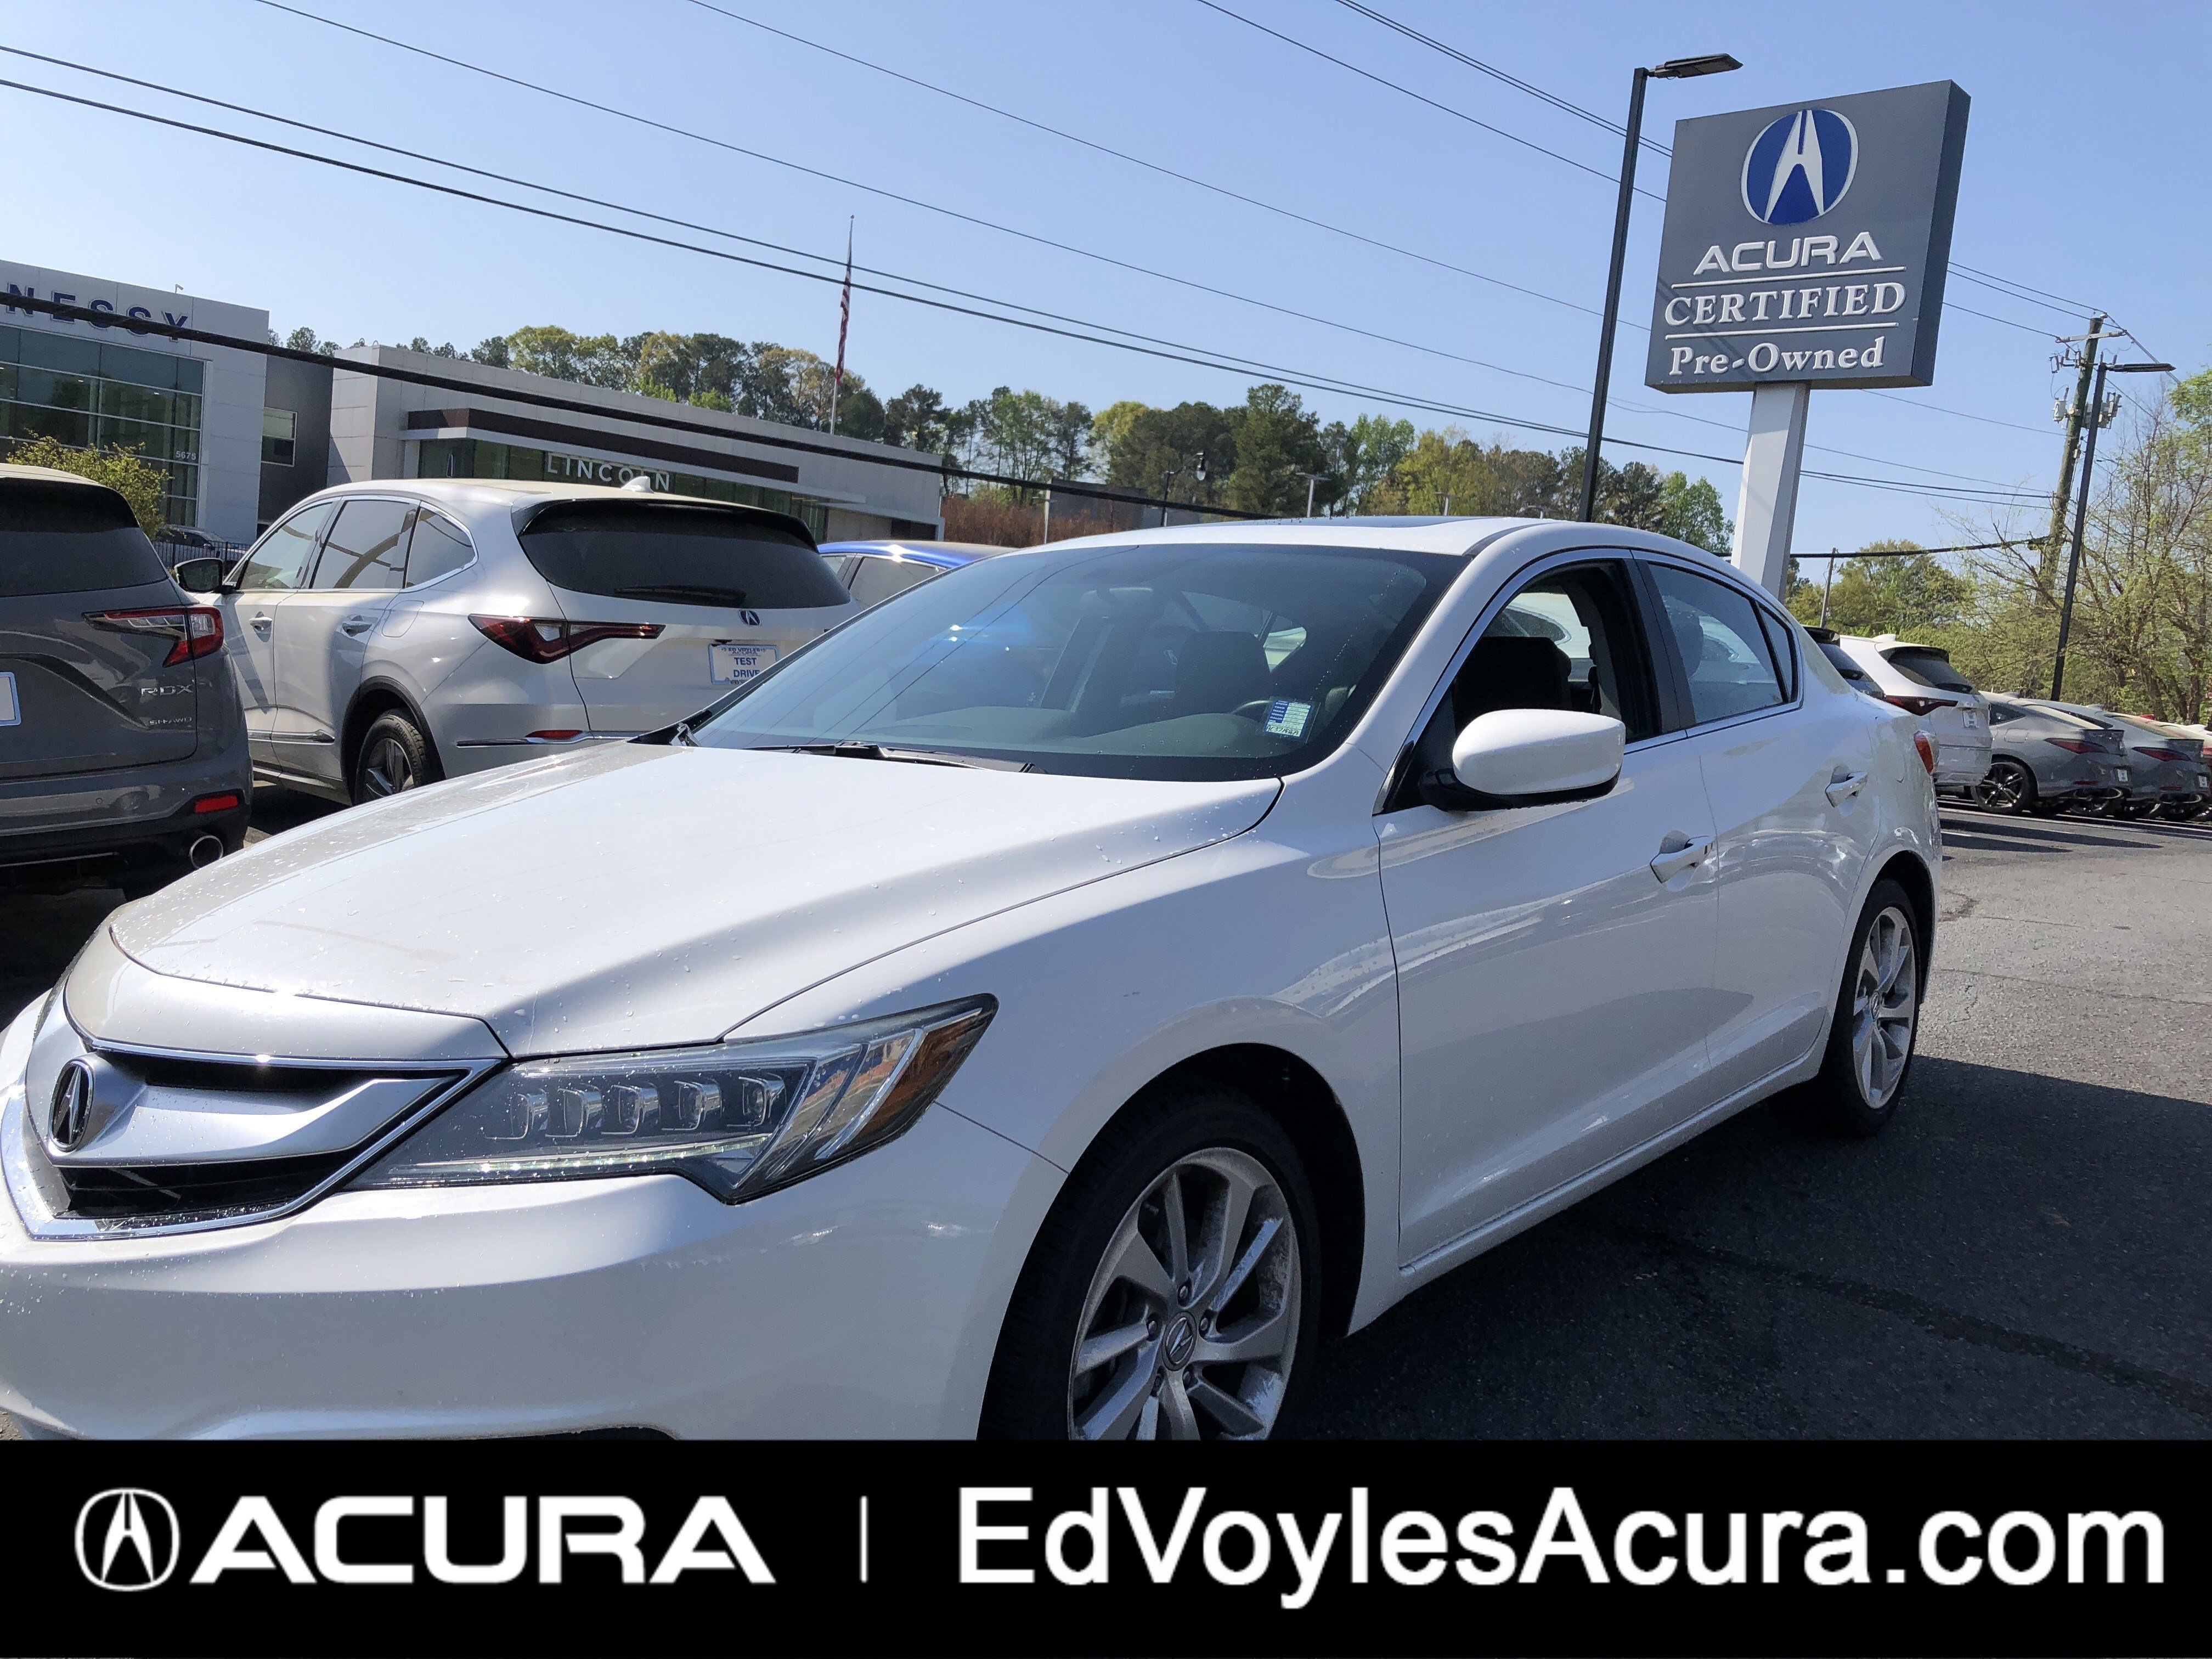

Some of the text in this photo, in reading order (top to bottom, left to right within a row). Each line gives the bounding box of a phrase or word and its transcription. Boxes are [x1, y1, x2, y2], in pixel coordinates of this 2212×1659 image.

[1693, 231, 1883, 276] ACURA
[1665, 281, 1907, 326] CERTIFIED
[1668, 336, 1886, 376] Pre-Owned
[176, 450, 196, 460] 5675
[733, 657, 757, 665] TEST
[141, 684, 193, 696] RDX
